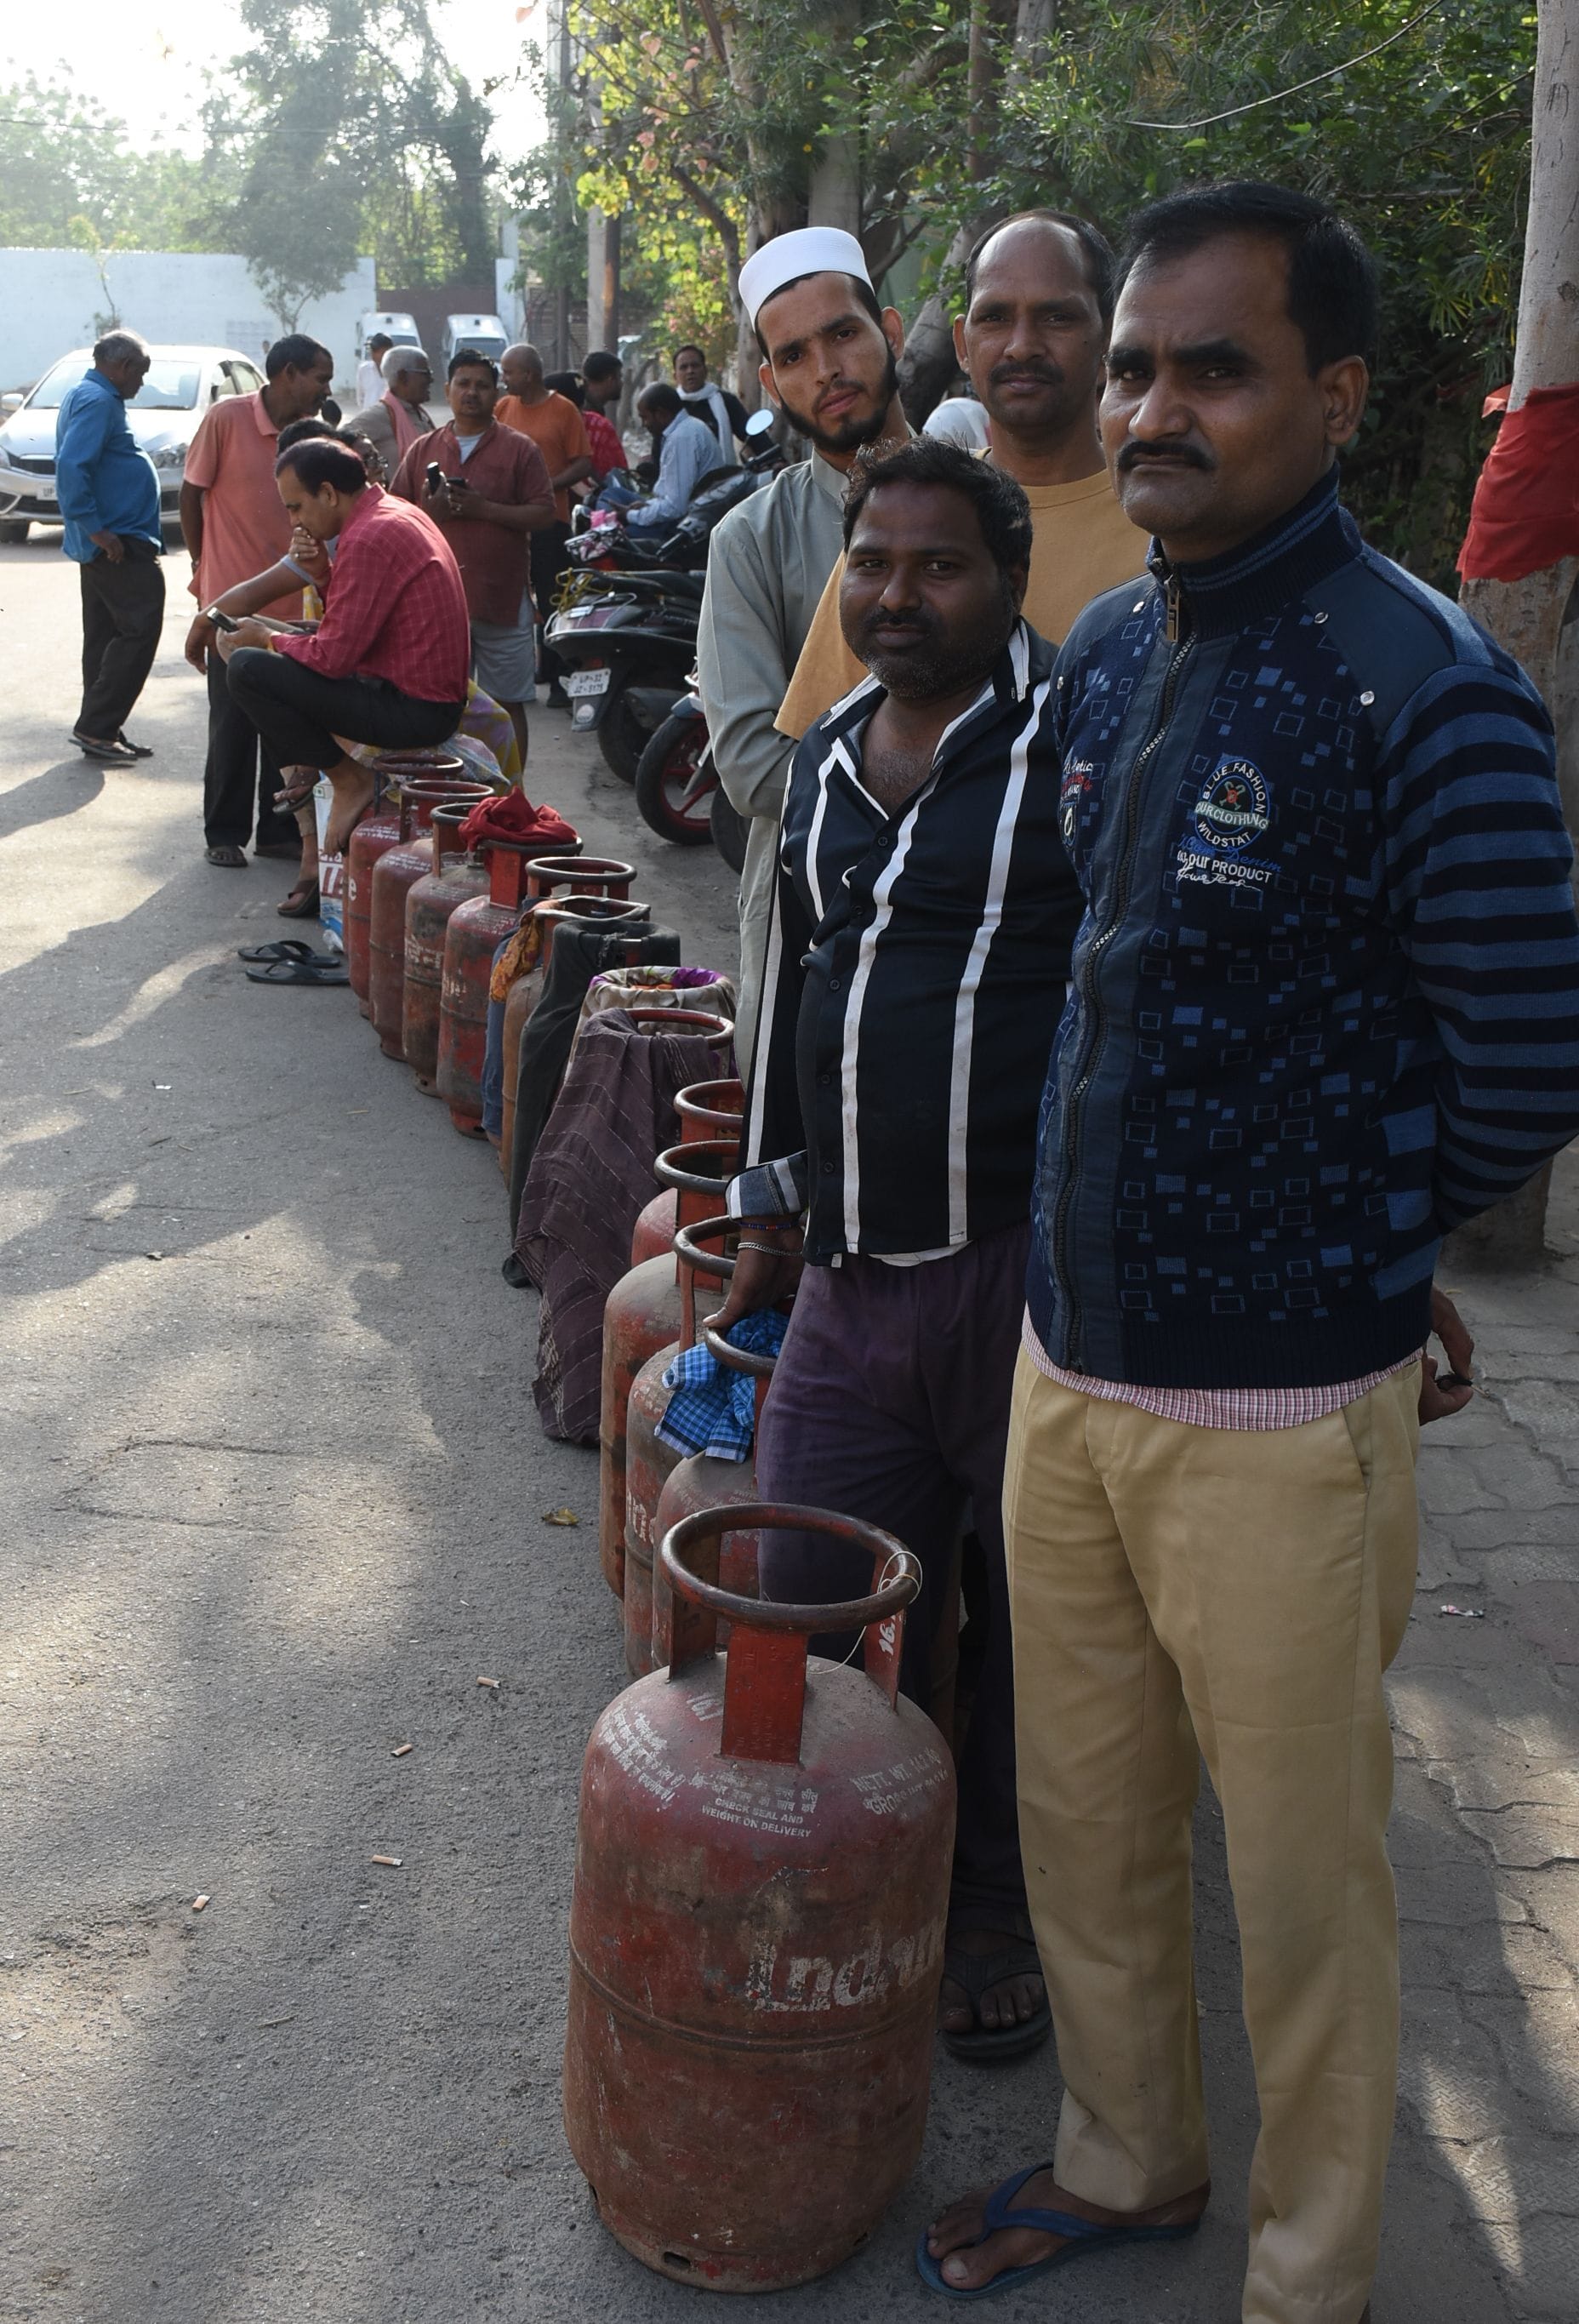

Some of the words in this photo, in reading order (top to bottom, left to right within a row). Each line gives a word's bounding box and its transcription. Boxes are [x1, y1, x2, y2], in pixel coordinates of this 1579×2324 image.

[1232, 762, 1267, 814] FASHION
[1211, 859, 1273, 884] PRODUCT
[701, 1804, 742, 1824] WEIGHT
[743, 1815, 759, 1829] ON
[761, 1821, 812, 1838] DELIVERY
[715, 1796, 750, 1814] CHECK
[752, 1807, 778, 1821] SEAL
[780, 1813, 804, 1825] AND
